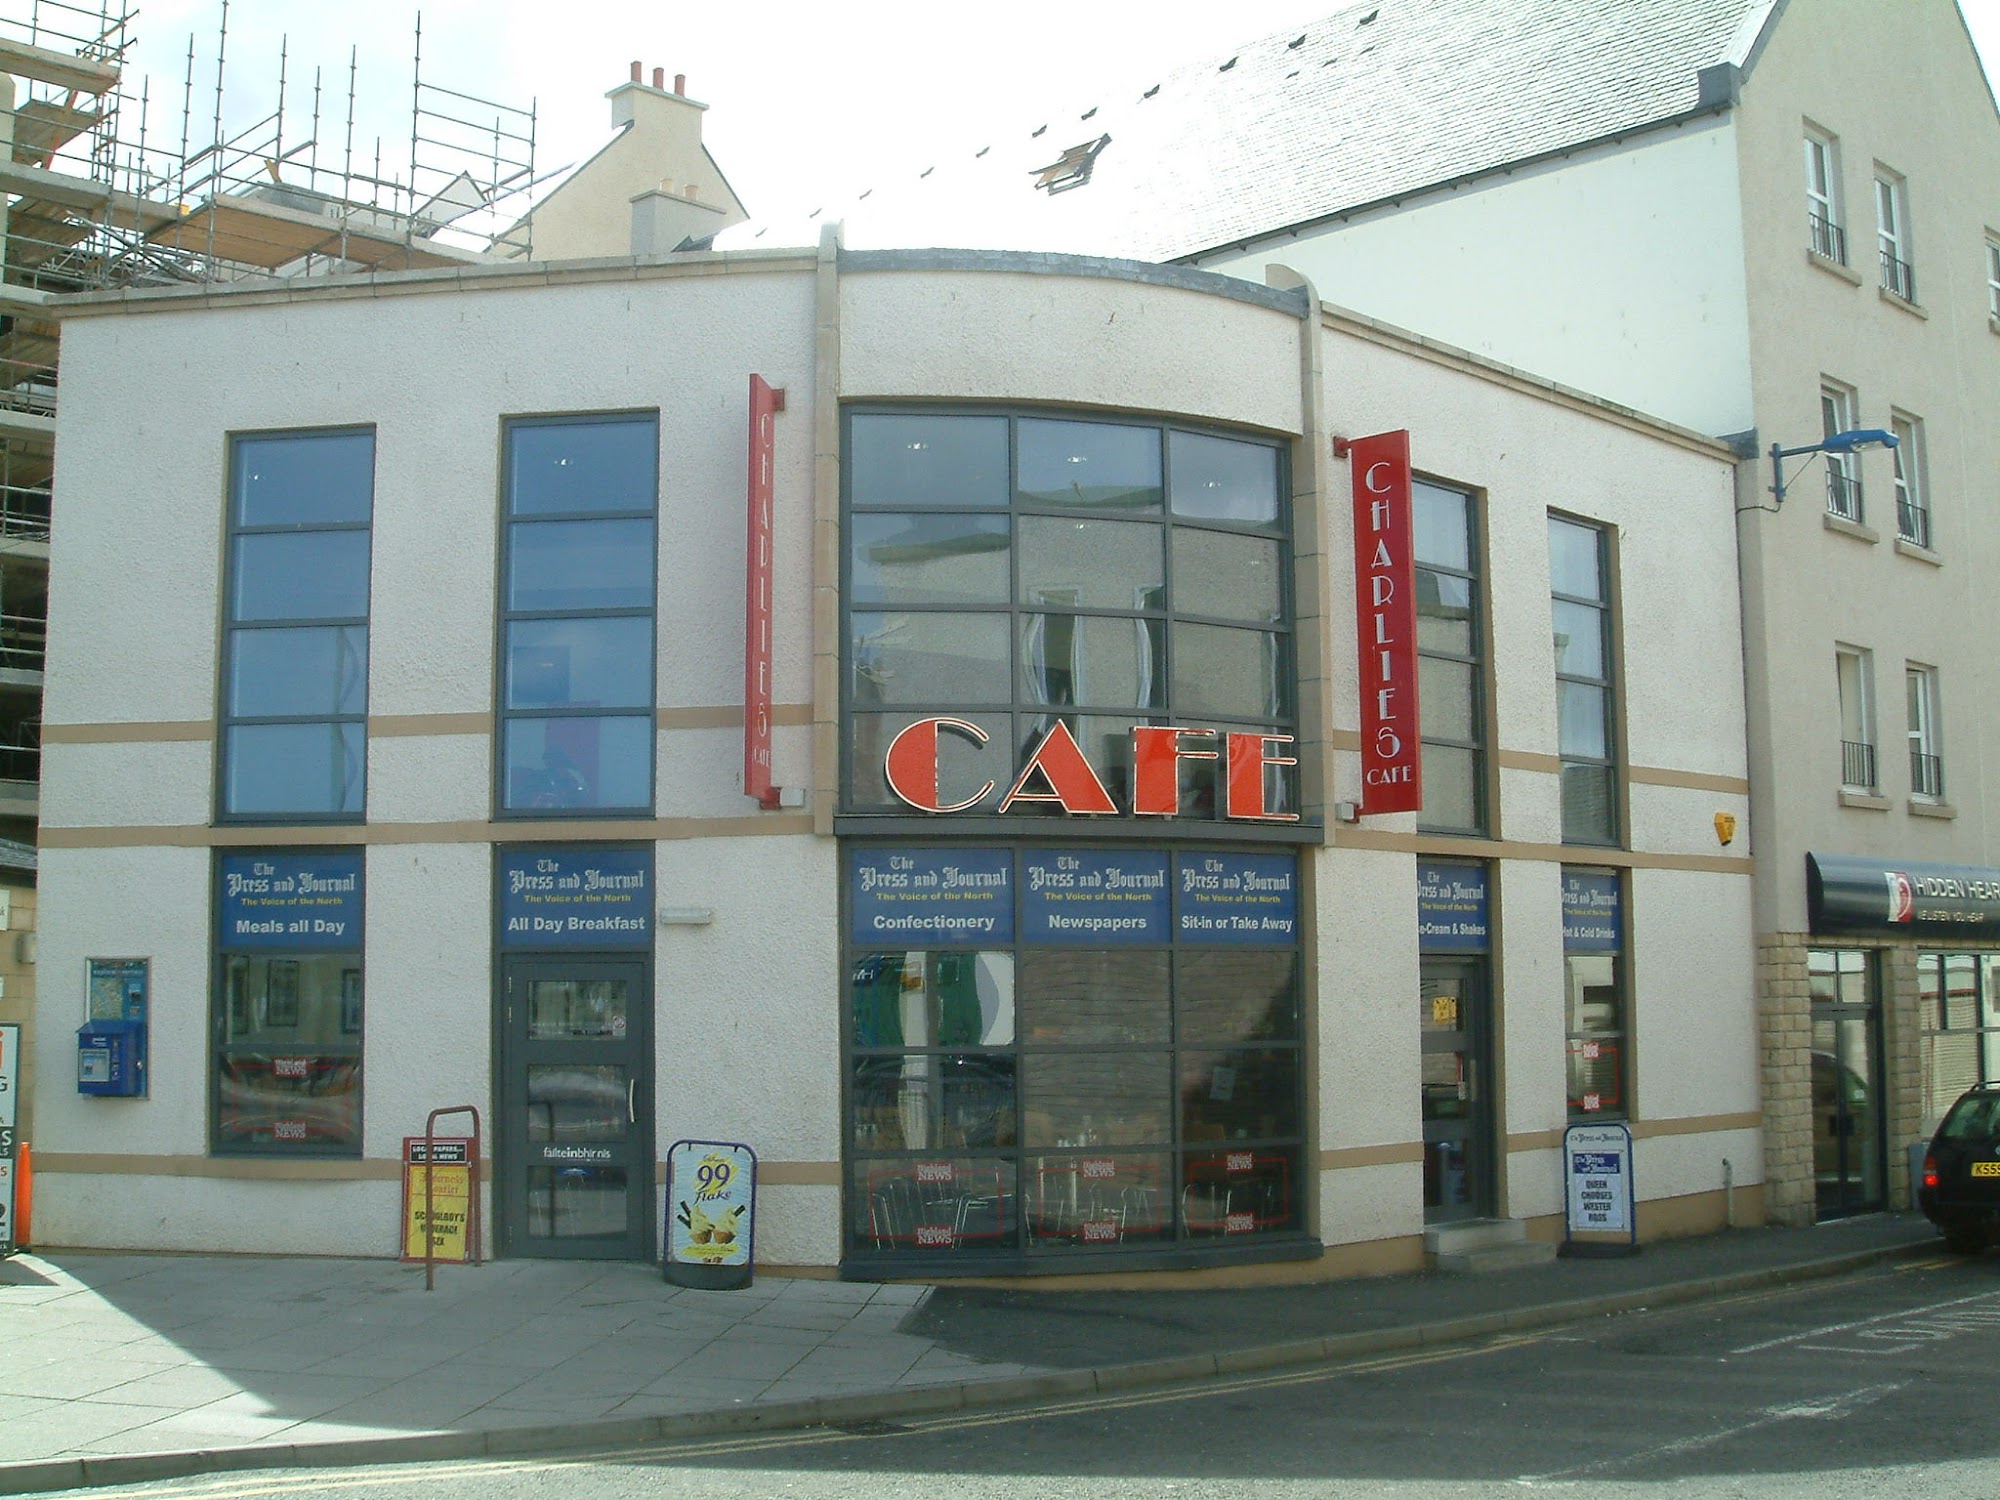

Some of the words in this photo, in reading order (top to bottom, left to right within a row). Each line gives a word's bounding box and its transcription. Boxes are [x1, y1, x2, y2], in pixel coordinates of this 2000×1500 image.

[1366, 462, 1400, 759] CHARLIES
[885, 716, 1300, 820] CAFE
[1367, 765, 1412, 785] CAFE
[254, 863, 275, 875] The
[537, 859, 559, 872] The
[890, 856, 914, 870] The
[1057, 856, 1080, 870] The
[1205, 859, 1223, 872] The
[227, 873, 269, 897] Press
[274, 876, 295, 892] and
[298, 873, 355, 894] Journal
[509, 870, 553, 893] Press
[558, 873, 580, 889] and
[584, 869, 645, 891] Journal
[859, 867, 908, 891] Press
[914, 870, 938, 887] and
[942, 866, 1007, 889] Journal
[1029, 866, 1074, 890] Press
[1079, 871, 1101, 888] and
[1105, 868, 1164, 890] Journal
[1182, 868, 1219, 892] Press
[1223, 873, 1240, 889] and
[1243, 871, 1290, 892] Journal
[1913, 876, 1966, 898] HIDDEN
[1967, 879, 2000, 900] HEAR
[242, 898, 257, 906] The
[261, 898, 284, 906] Voice
[287, 898, 297, 906] of
[300, 898, 314, 906] the
[316, 898, 342, 906] North
[524, 894, 541, 903] The
[545, 894, 570, 903] Voice
[573, 894, 583, 903] of
[586, 894, 601, 903] the
[604, 894, 631, 903] North
[876, 892, 895, 900] The
[899, 892, 927, 900] Voice
[930, 892, 941, 900] of
[944, 892, 961, 900] the
[964, 892, 993, 900] North
[1044, 892, 1062, 900] The
[1066, 892, 1092, 900] Voice
[1095, 892, 1104, 900] of
[1107, 892, 1122, 900] the
[1125, 892, 1152, 900] North
[236, 920, 284, 933] Meals
[289, 920, 309, 933] all
[314, 920, 345, 935] Day
[508, 917, 529, 930] All
[534, 917, 563, 933] Day
[568, 917, 645, 930] Breakfast
[873, 915, 994, 931] Confectionery
[1048, 915, 1147, 931] Newspapers
[1182, 915, 1212, 929] Sit-in
[1216, 918, 1228, 929] or
[1230, 916, 1258, 929] Take
[1261, 917, 1292, 933] Away
[1452, 922, 1458, 935] &
[1460, 923, 1486, 935] Shakes
[697, 1163, 731, 1191] 99
[917, 1171, 952, 1181] NEWS
[1083, 1168, 1115, 1178] NEWS
[1585, 1180, 1608, 1189] QUEEN
[693, 1189, 732, 1205] Flake
[1581, 1191, 1613, 1200] CHOOSES
[1583, 1202, 1612, 1211] WESTER
[918, 1235, 952, 1245] NEWS
[1084, 1230, 1116, 1240] NEWS
